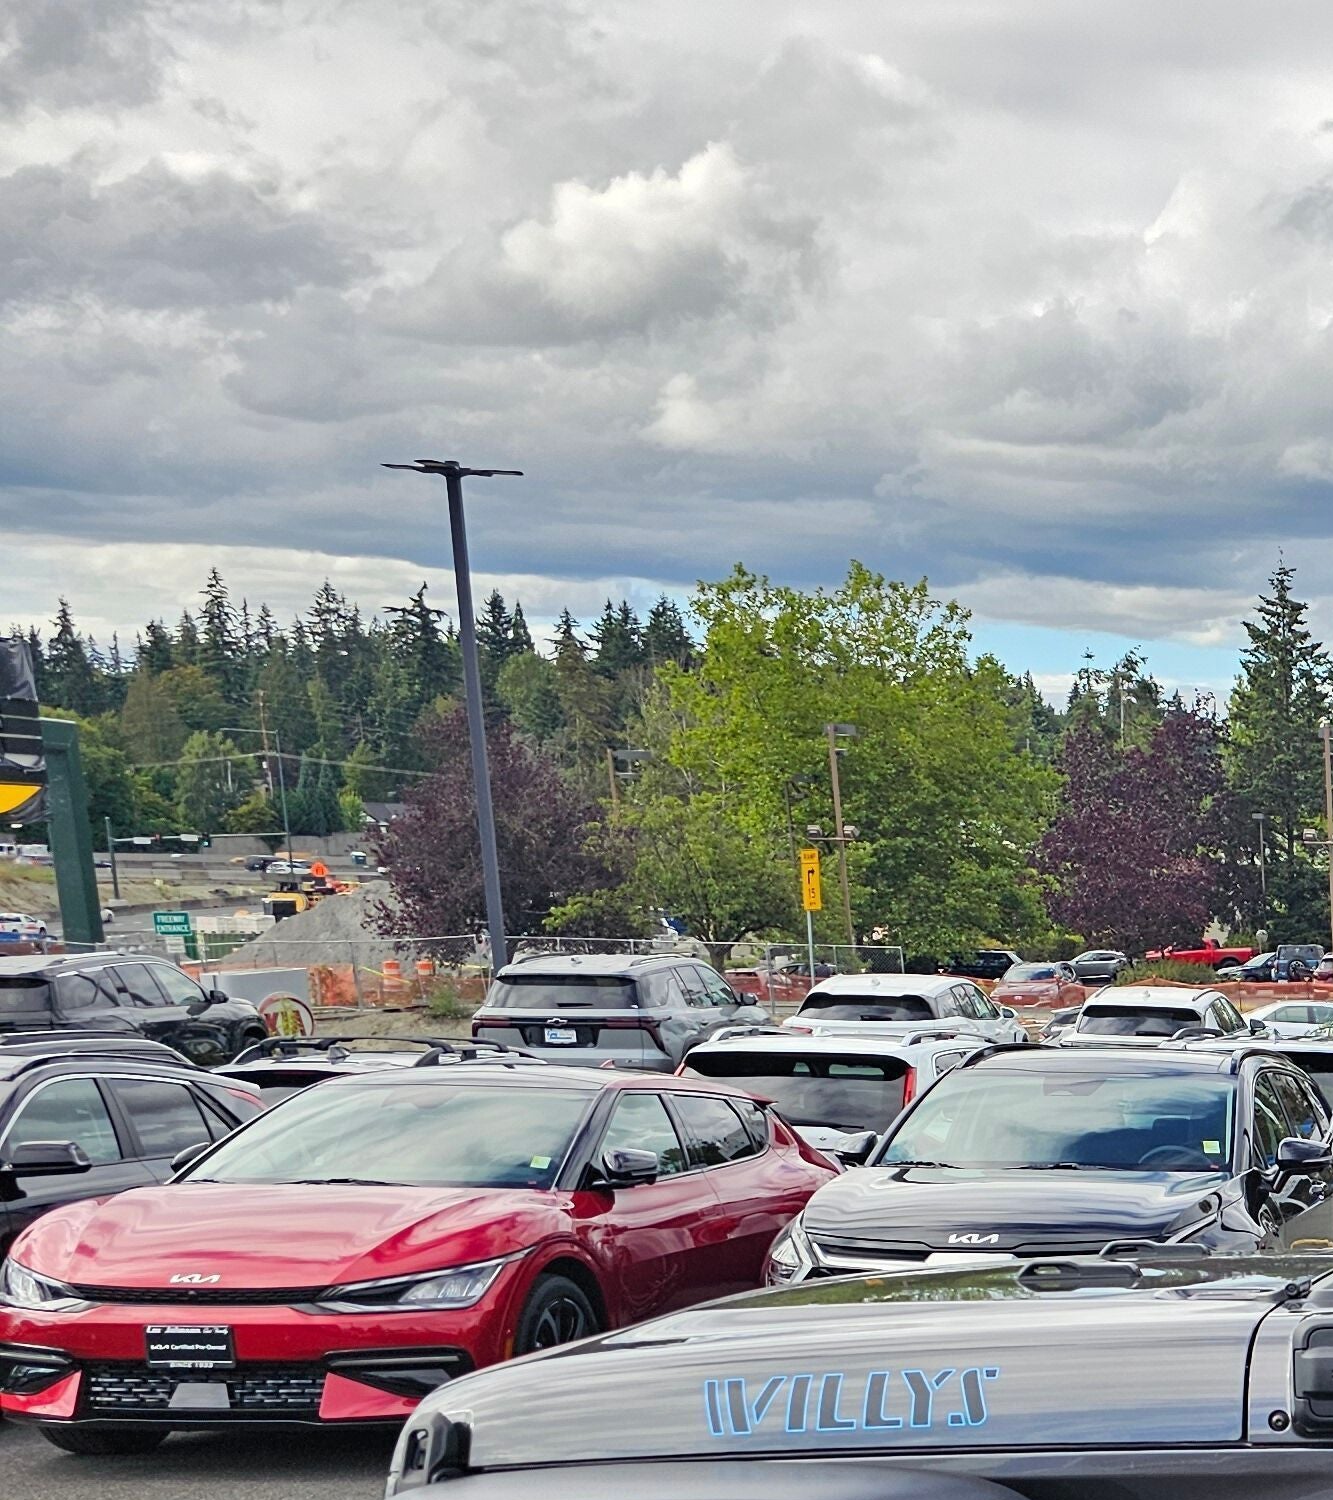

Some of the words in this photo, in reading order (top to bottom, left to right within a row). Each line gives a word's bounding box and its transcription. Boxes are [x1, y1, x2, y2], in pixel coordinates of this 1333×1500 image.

[948, 1233, 999, 1244] KIA
[170, 1273, 221, 1284] KIA
[705, 1368, 1000, 1436] WILLYS
